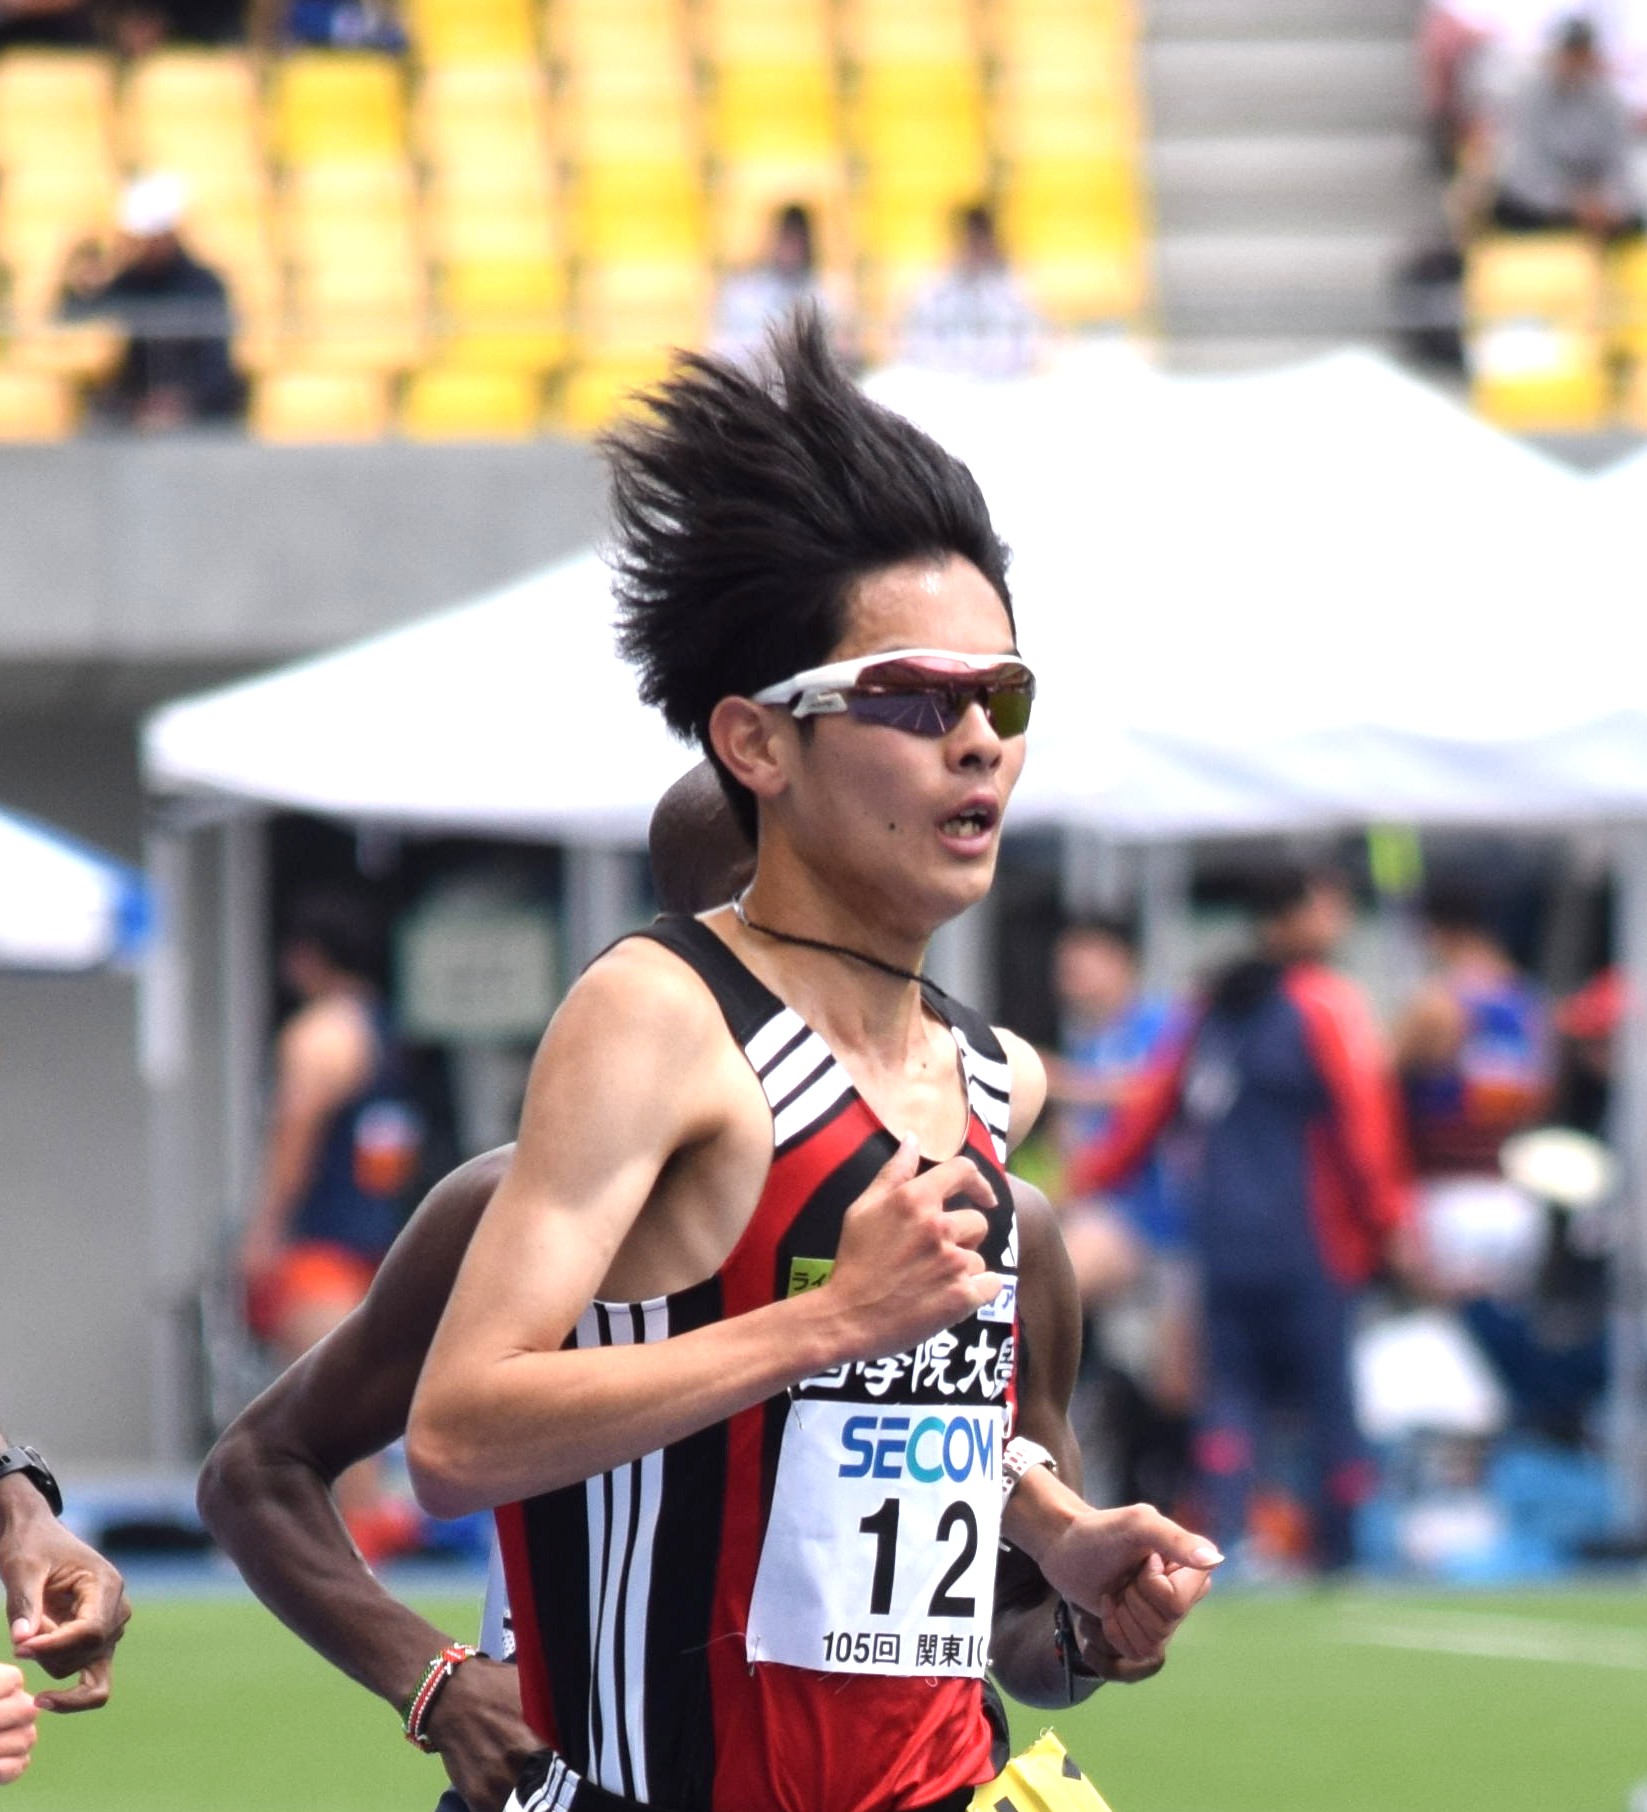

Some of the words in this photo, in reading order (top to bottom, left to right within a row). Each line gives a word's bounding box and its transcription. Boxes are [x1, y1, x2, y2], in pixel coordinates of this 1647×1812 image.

[838, 1415, 994, 1484] SECOM
[859, 1497, 978, 1618] 12
[822, 1631, 901, 1665] 105回
